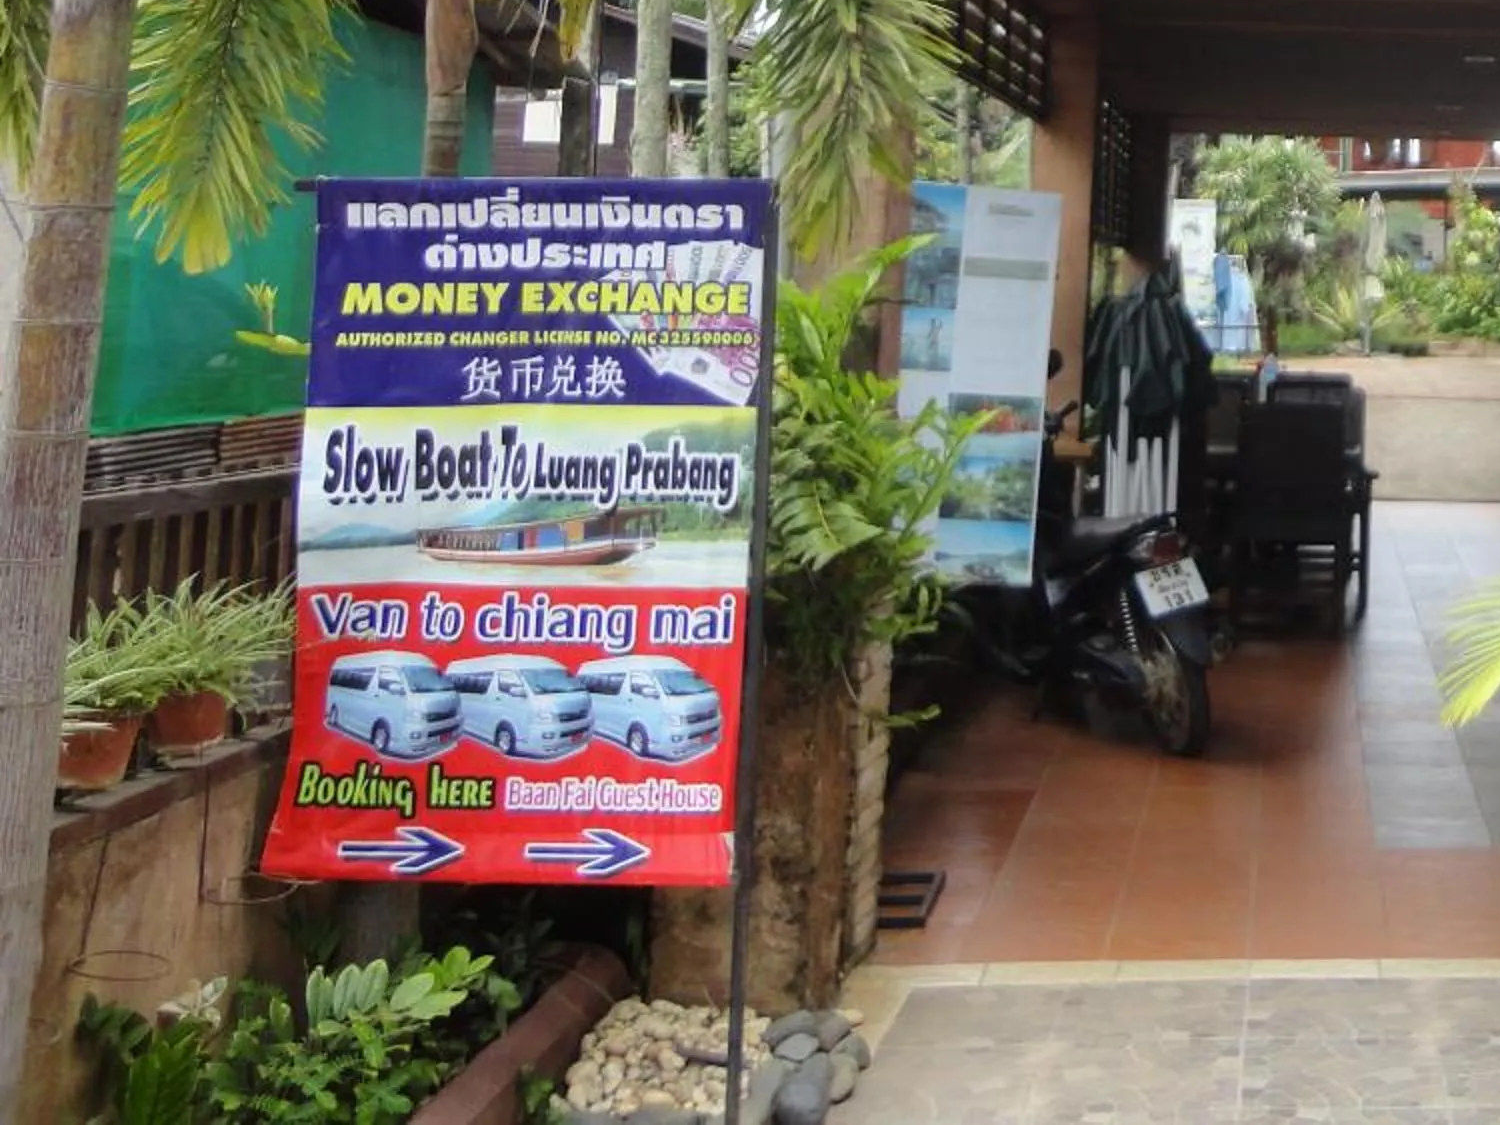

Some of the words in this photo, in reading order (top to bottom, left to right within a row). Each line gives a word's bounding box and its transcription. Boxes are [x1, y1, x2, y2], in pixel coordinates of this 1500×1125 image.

[347, 186, 744, 229] แลกเปลี่ยนเงินตรา
[425, 233, 667, 269] ต่างประเทศ
[341, 282, 508, 315] MONEY
[520, 281, 750, 314] EXCHANGE
[335, 331, 446, 348] AUTHORIZED
[449, 330, 530, 347] CHANGER
[534, 329, 592, 345] LICENSE
[460, 353, 627, 401] 货币兑换
[322, 424, 406, 494] Slow
[414, 428, 493, 491] Boat
[500, 424, 529, 492] To
[533, 441, 617, 505] Luang
[624, 440, 736, 507] Prabang
[313, 595, 408, 637] Van
[423, 594, 464, 638] to
[477, 593, 635, 651] chiang
[652, 596, 734, 643] mai
[507, 779, 558, 809] Baan
[562, 778, 593, 809] Fai
[600, 780, 654, 810] Guest
[660, 779, 720, 811] House
